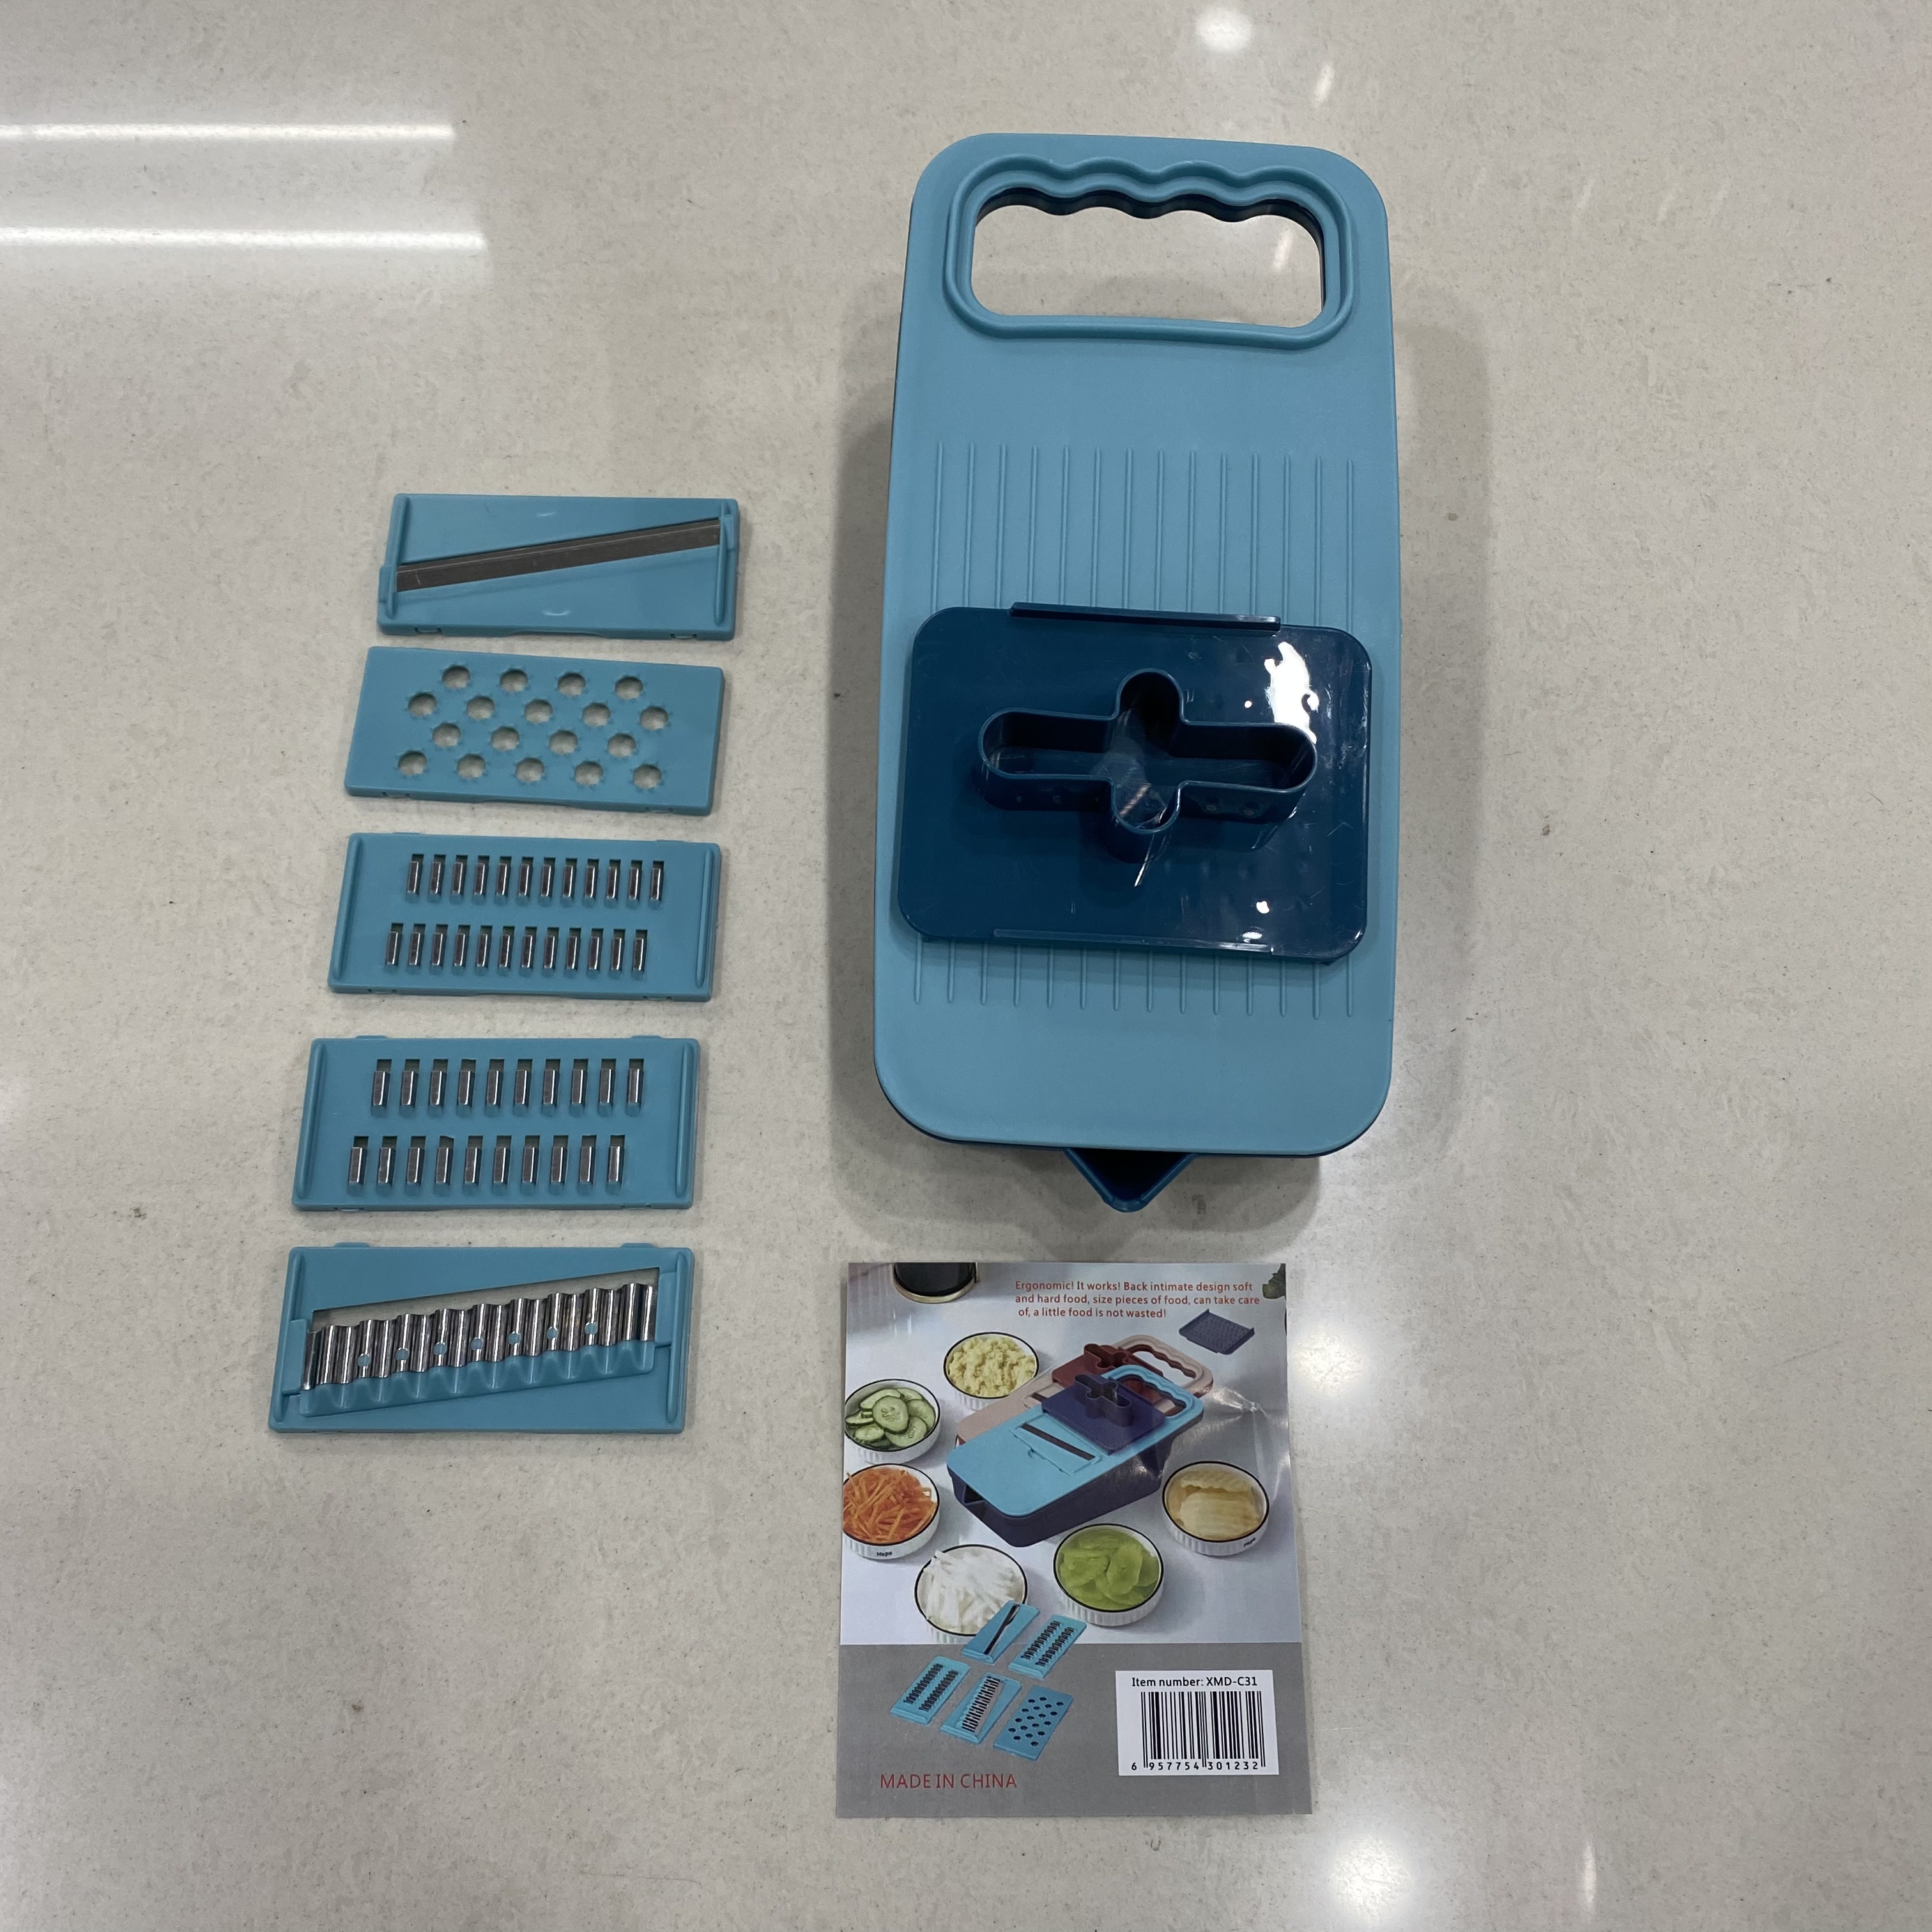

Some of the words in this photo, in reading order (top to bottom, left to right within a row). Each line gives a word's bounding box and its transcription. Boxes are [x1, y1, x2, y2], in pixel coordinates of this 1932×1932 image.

[1015, 1281, 1074, 1292] Ergonomic!
[1077, 1281, 1084, 1290] It
[1087, 1281, 1121, 1291] works!
[1124, 1282, 1148, 1291] Back
[1150, 1282, 1193, 1291] intimate
[1196, 1282, 1230, 1293] design
[1232, 1282, 1253, 1291] soft
[1015, 1294, 1034, 1303] and
[1037, 1294, 1060, 1303] hard
[1063, 1294, 1090, 1305] food,
[1092, 1294, 1112, 1304] size
[1116, 1295, 1148, 1306] pieces
[1151, 1295, 1162, 1305] of
[1164, 1295, 1191, 1305] food,
[1214, 1296, 1236, 1305] take
[1018, 1307, 1030, 1317] of,
[1041, 1307, 1066, 1317] little
[1069, 1307, 1092, 1317] food
[1096, 1308, 1103, 1317] is
[1106, 1309, 1123, 1317] not
[1126, 1308, 1166, 1318] wasted!
[1131, 1677, 1156, 1687] Item
[1159, 1677, 1204, 1687] number:
[1206, 1676, 1257, 1687] XMD-C31
[880, 1774, 931, 1788] MADE
[936, 1774, 954, 1788] IN
[960, 1774, 1017, 1788] CHINA
